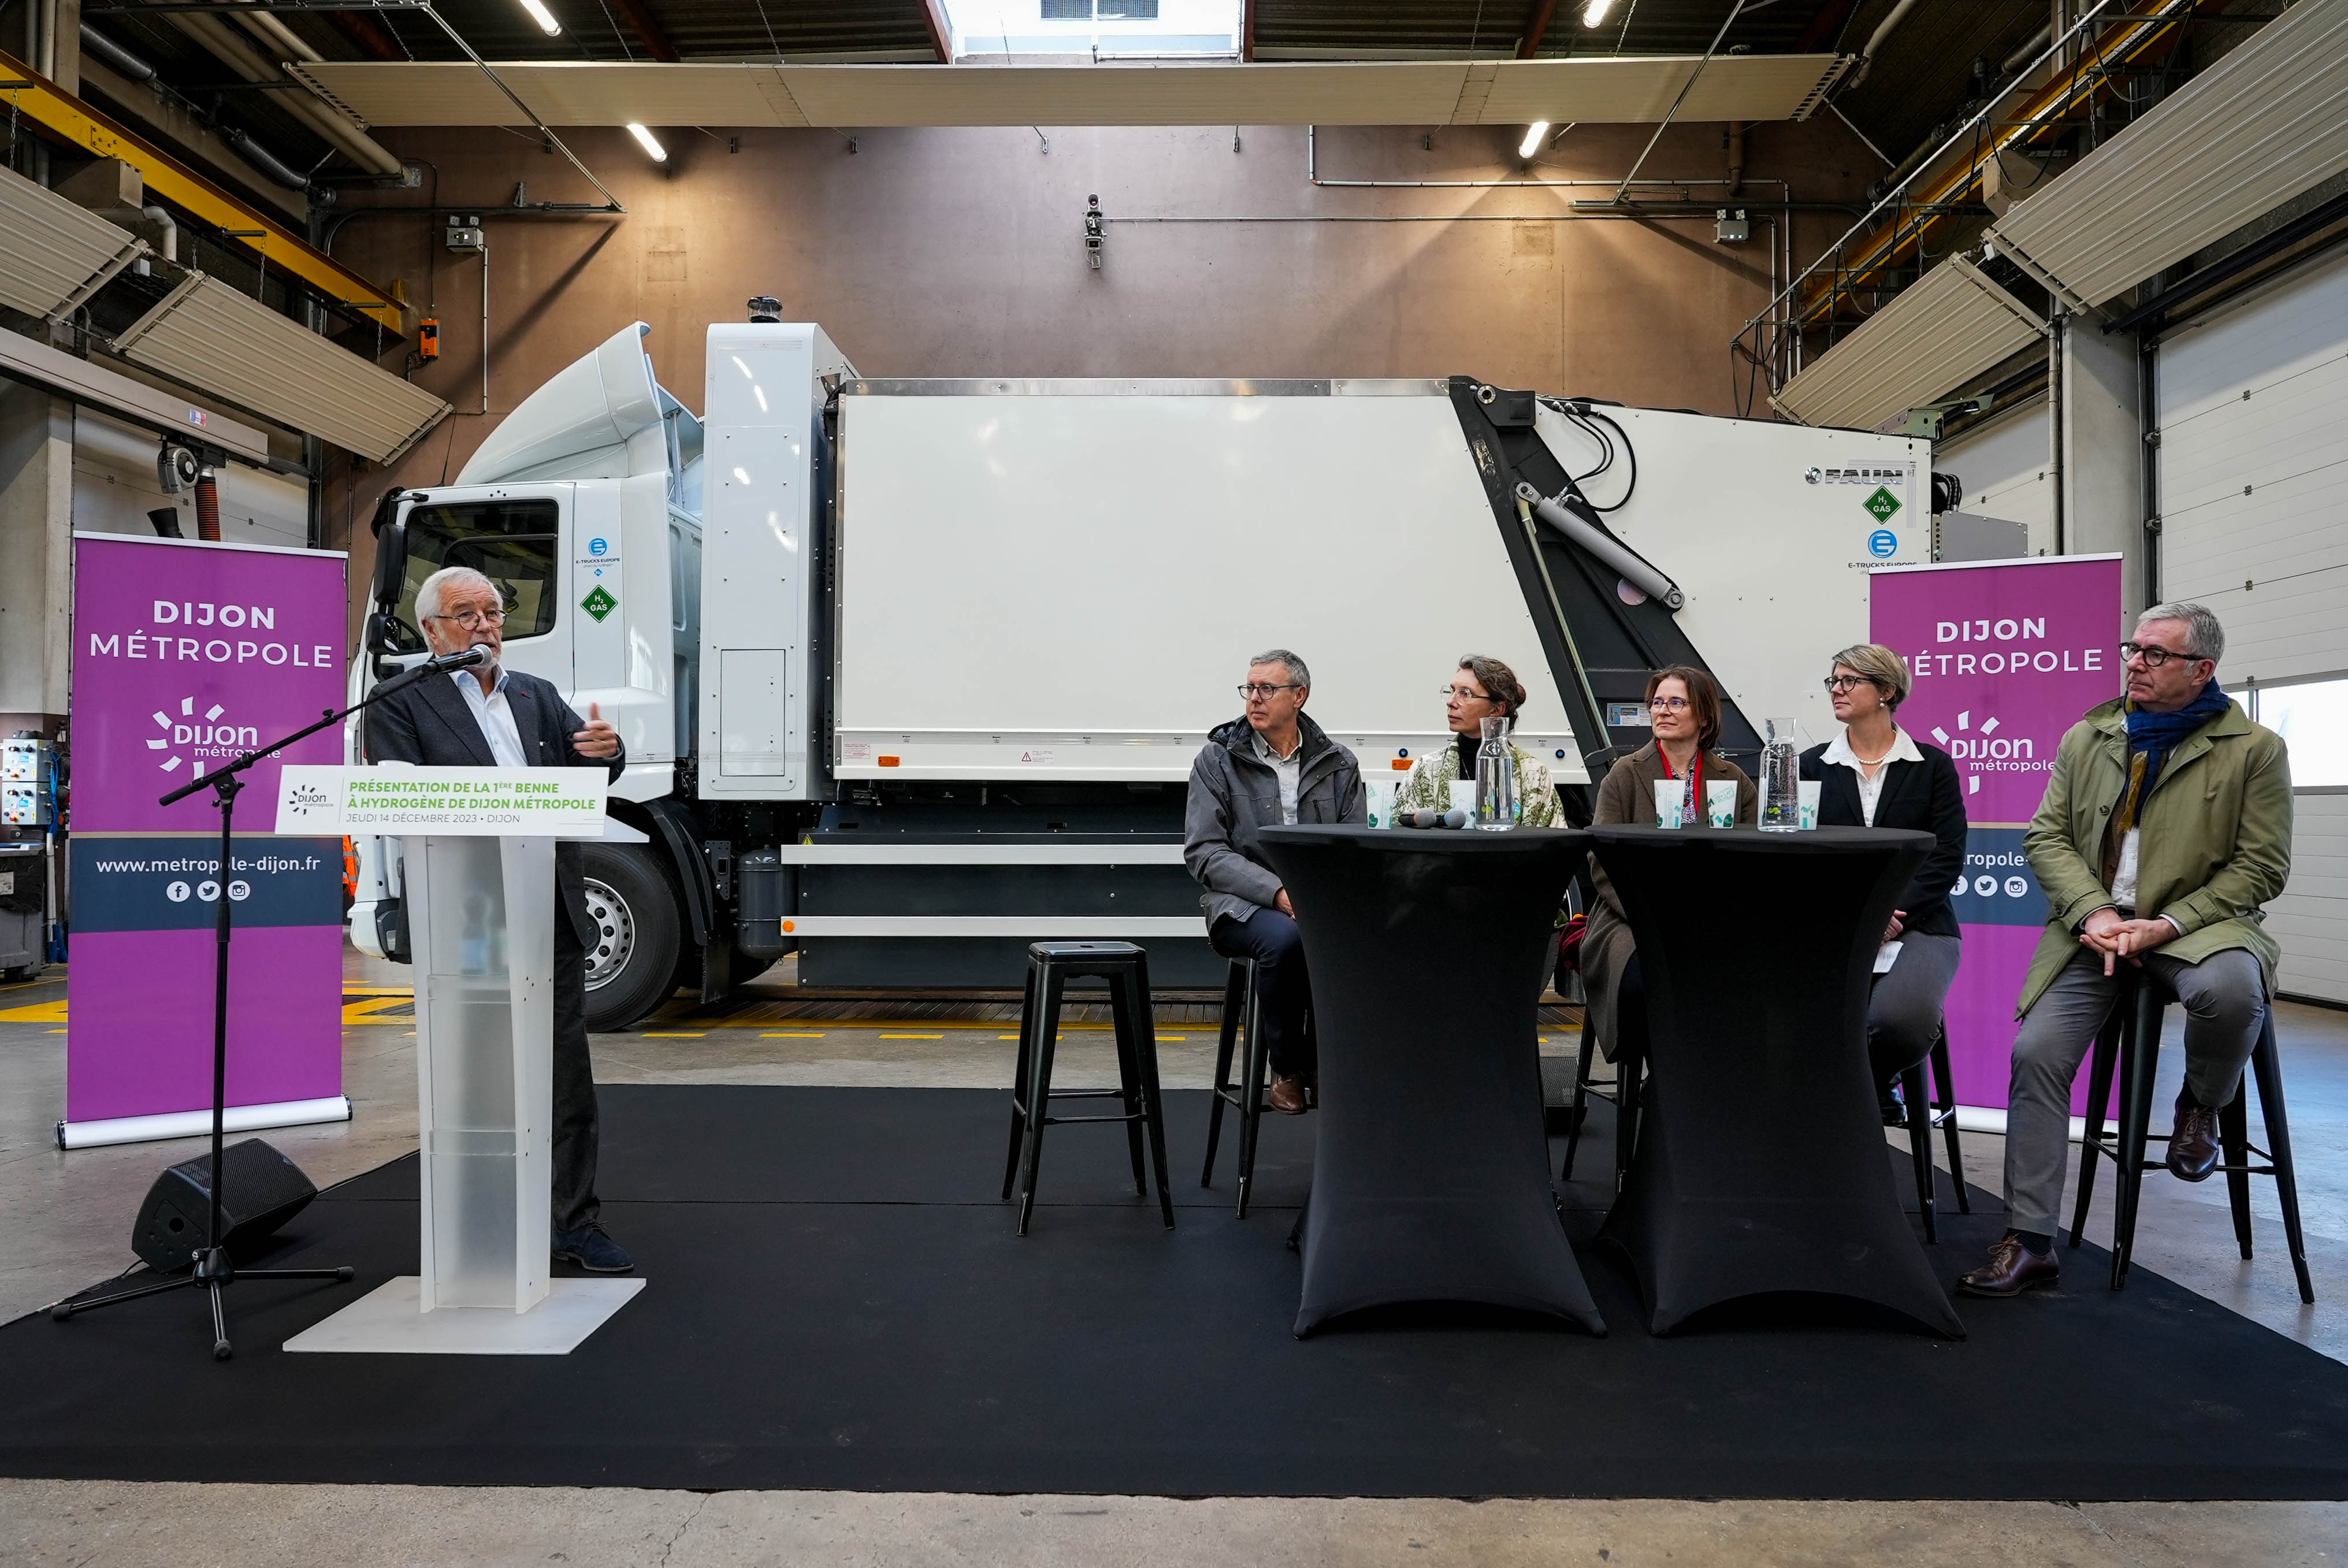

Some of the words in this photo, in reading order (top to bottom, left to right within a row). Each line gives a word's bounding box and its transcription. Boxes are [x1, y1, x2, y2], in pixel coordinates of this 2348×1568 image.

[1825, 469, 1903, 485] FAUN
[154, 600, 274, 630] DIJON
[1937, 617, 2045, 642] DIJON
[90, 629, 332, 668] MÉTROPOLE
[1902, 649, 2102, 676] ÉTROPOLE
[350, 778, 449, 792] PRÉSENTATION
[453, 782, 471, 793] DE
[474, 783, 490, 793] LA
[515, 783, 559, 793] BENNE
[348, 794, 358, 808] À
[361, 794, 445, 809] HYDROGÈNE
[448, 798, 466, 809] DE
[469, 798, 510, 809] DIJON
[513, 795, 596, 809] MÉTROPOLE
[346, 813, 377, 823] JEUDI
[380, 813, 389, 823] 14
[392, 812, 450, 823] DÉCEMBRE
[453, 814, 477, 823] 2023
[487, 814, 521, 823] DIJON
[96, 856, 321, 875] www.metrople-dijon.fr
